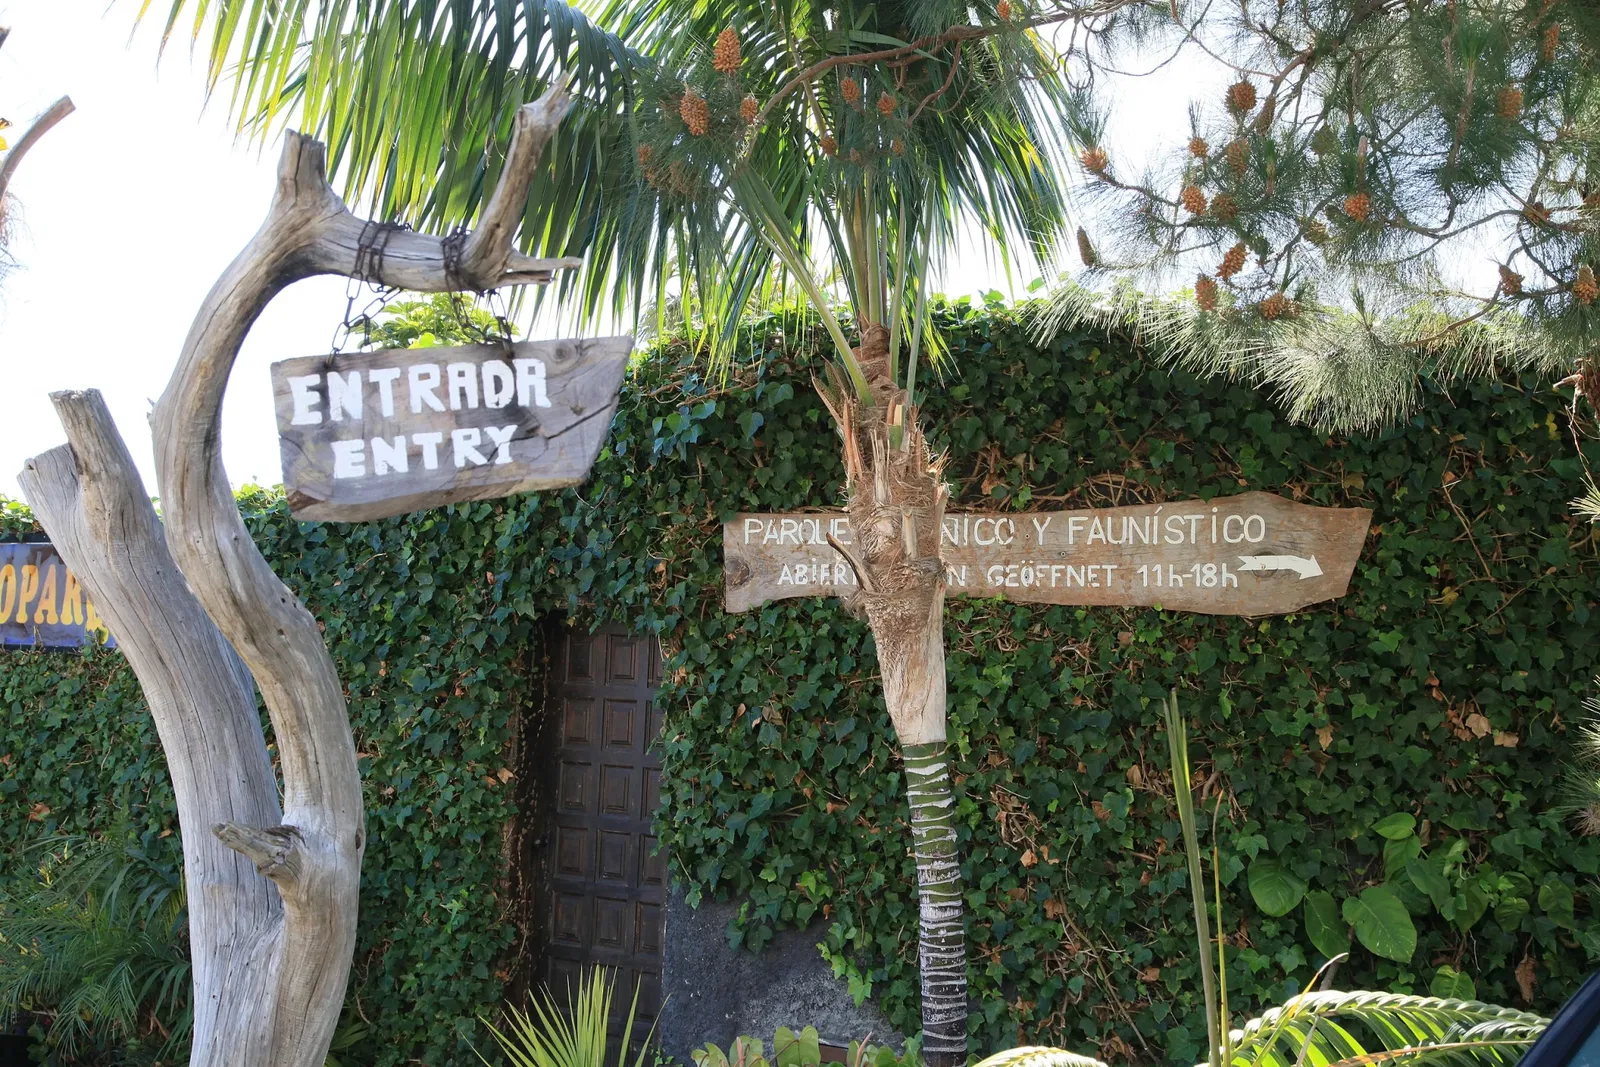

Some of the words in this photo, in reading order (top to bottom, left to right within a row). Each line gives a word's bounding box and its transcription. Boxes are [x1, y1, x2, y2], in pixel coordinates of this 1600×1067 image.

[286, 357, 552, 425] ENTRADA
[330, 424, 519, 480] ENTRY
[743, 517, 852, 546] PARQUE
[1032, 516, 1052, 546] Y
[986, 559, 1118, 588] GEÖFFNET
